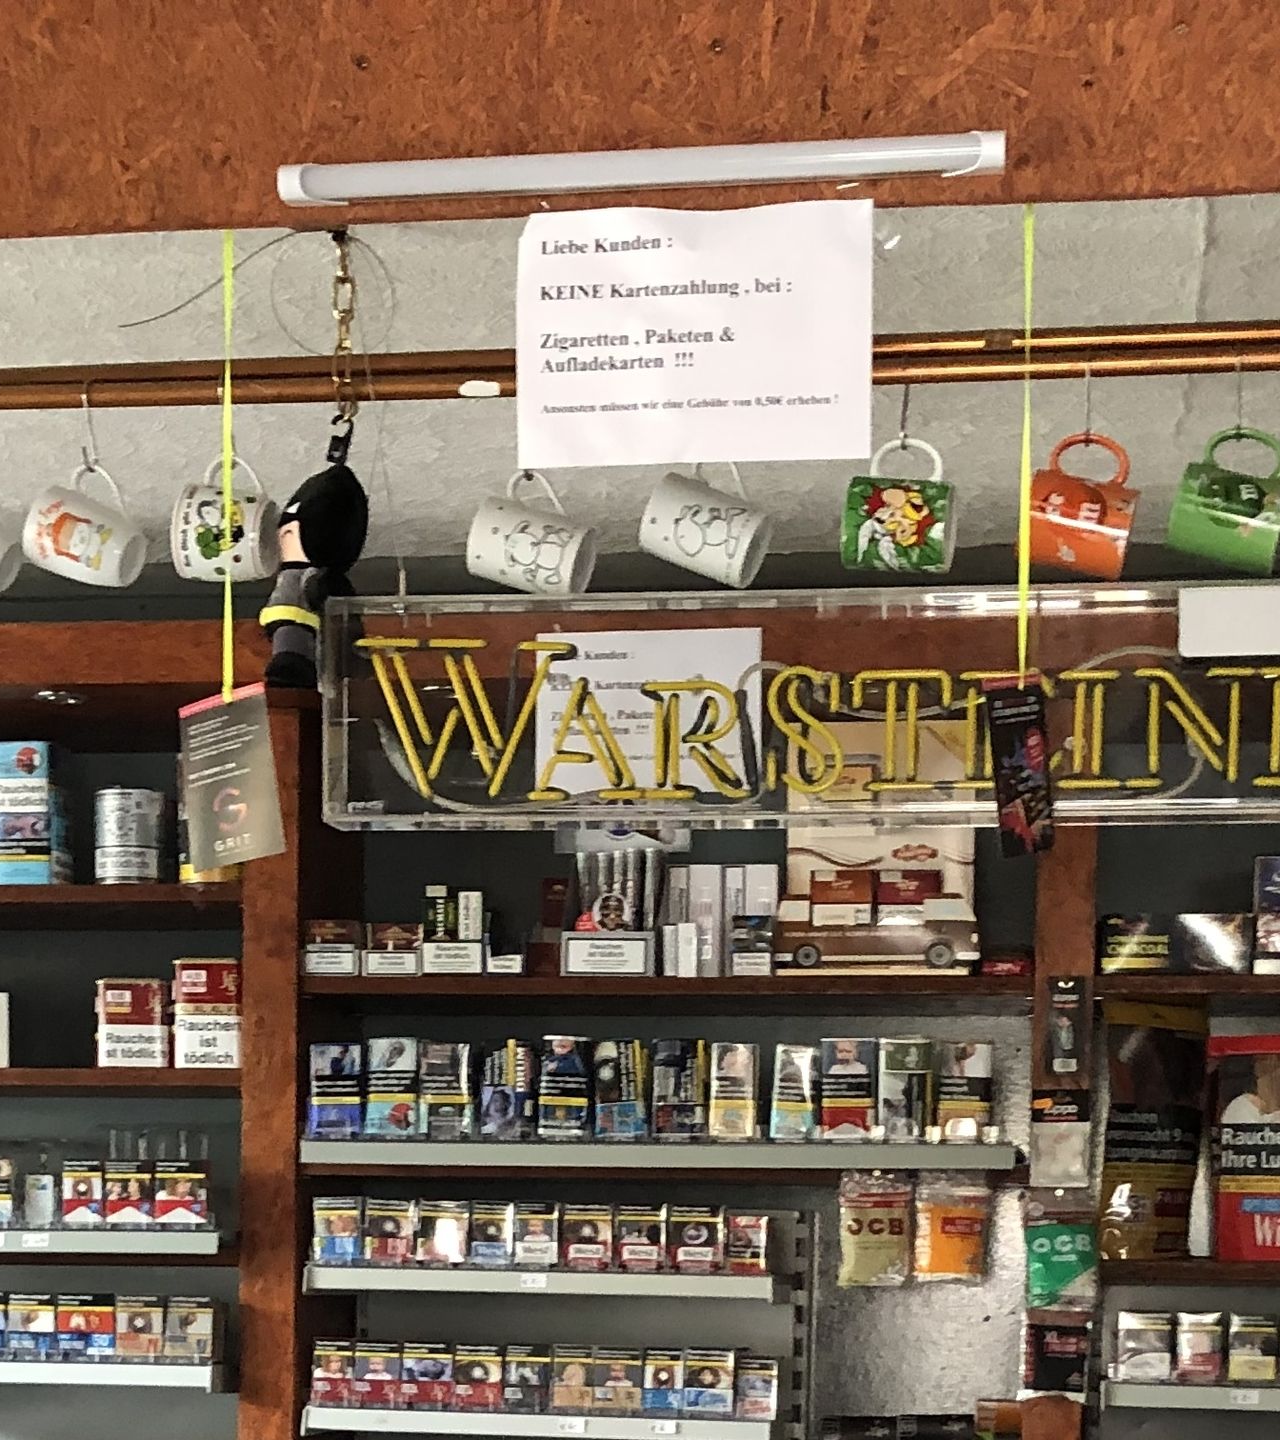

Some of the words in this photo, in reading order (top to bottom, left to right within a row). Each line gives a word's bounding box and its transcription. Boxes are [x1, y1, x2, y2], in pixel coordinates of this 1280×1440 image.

[541, 239, 589, 255] Liebe
[594, 236, 661, 253] Kunden
[540, 284, 604, 301] KEINE
[610, 278, 740, 299] Kartenzahlung
[754, 277, 782, 294] bei
[540, 330, 629, 352] Zigaretten
[645, 328, 714, 346] Paketen
[719, 327, 735, 342] &
[540, 355, 664, 374] Aufladekarten
[214, 832, 251, 852] GRIT
[1220, 1152, 1258, 1169] Ihre
[846, 1217, 905, 1236] OCB
[1031, 1233, 1093, 1254] OCB
